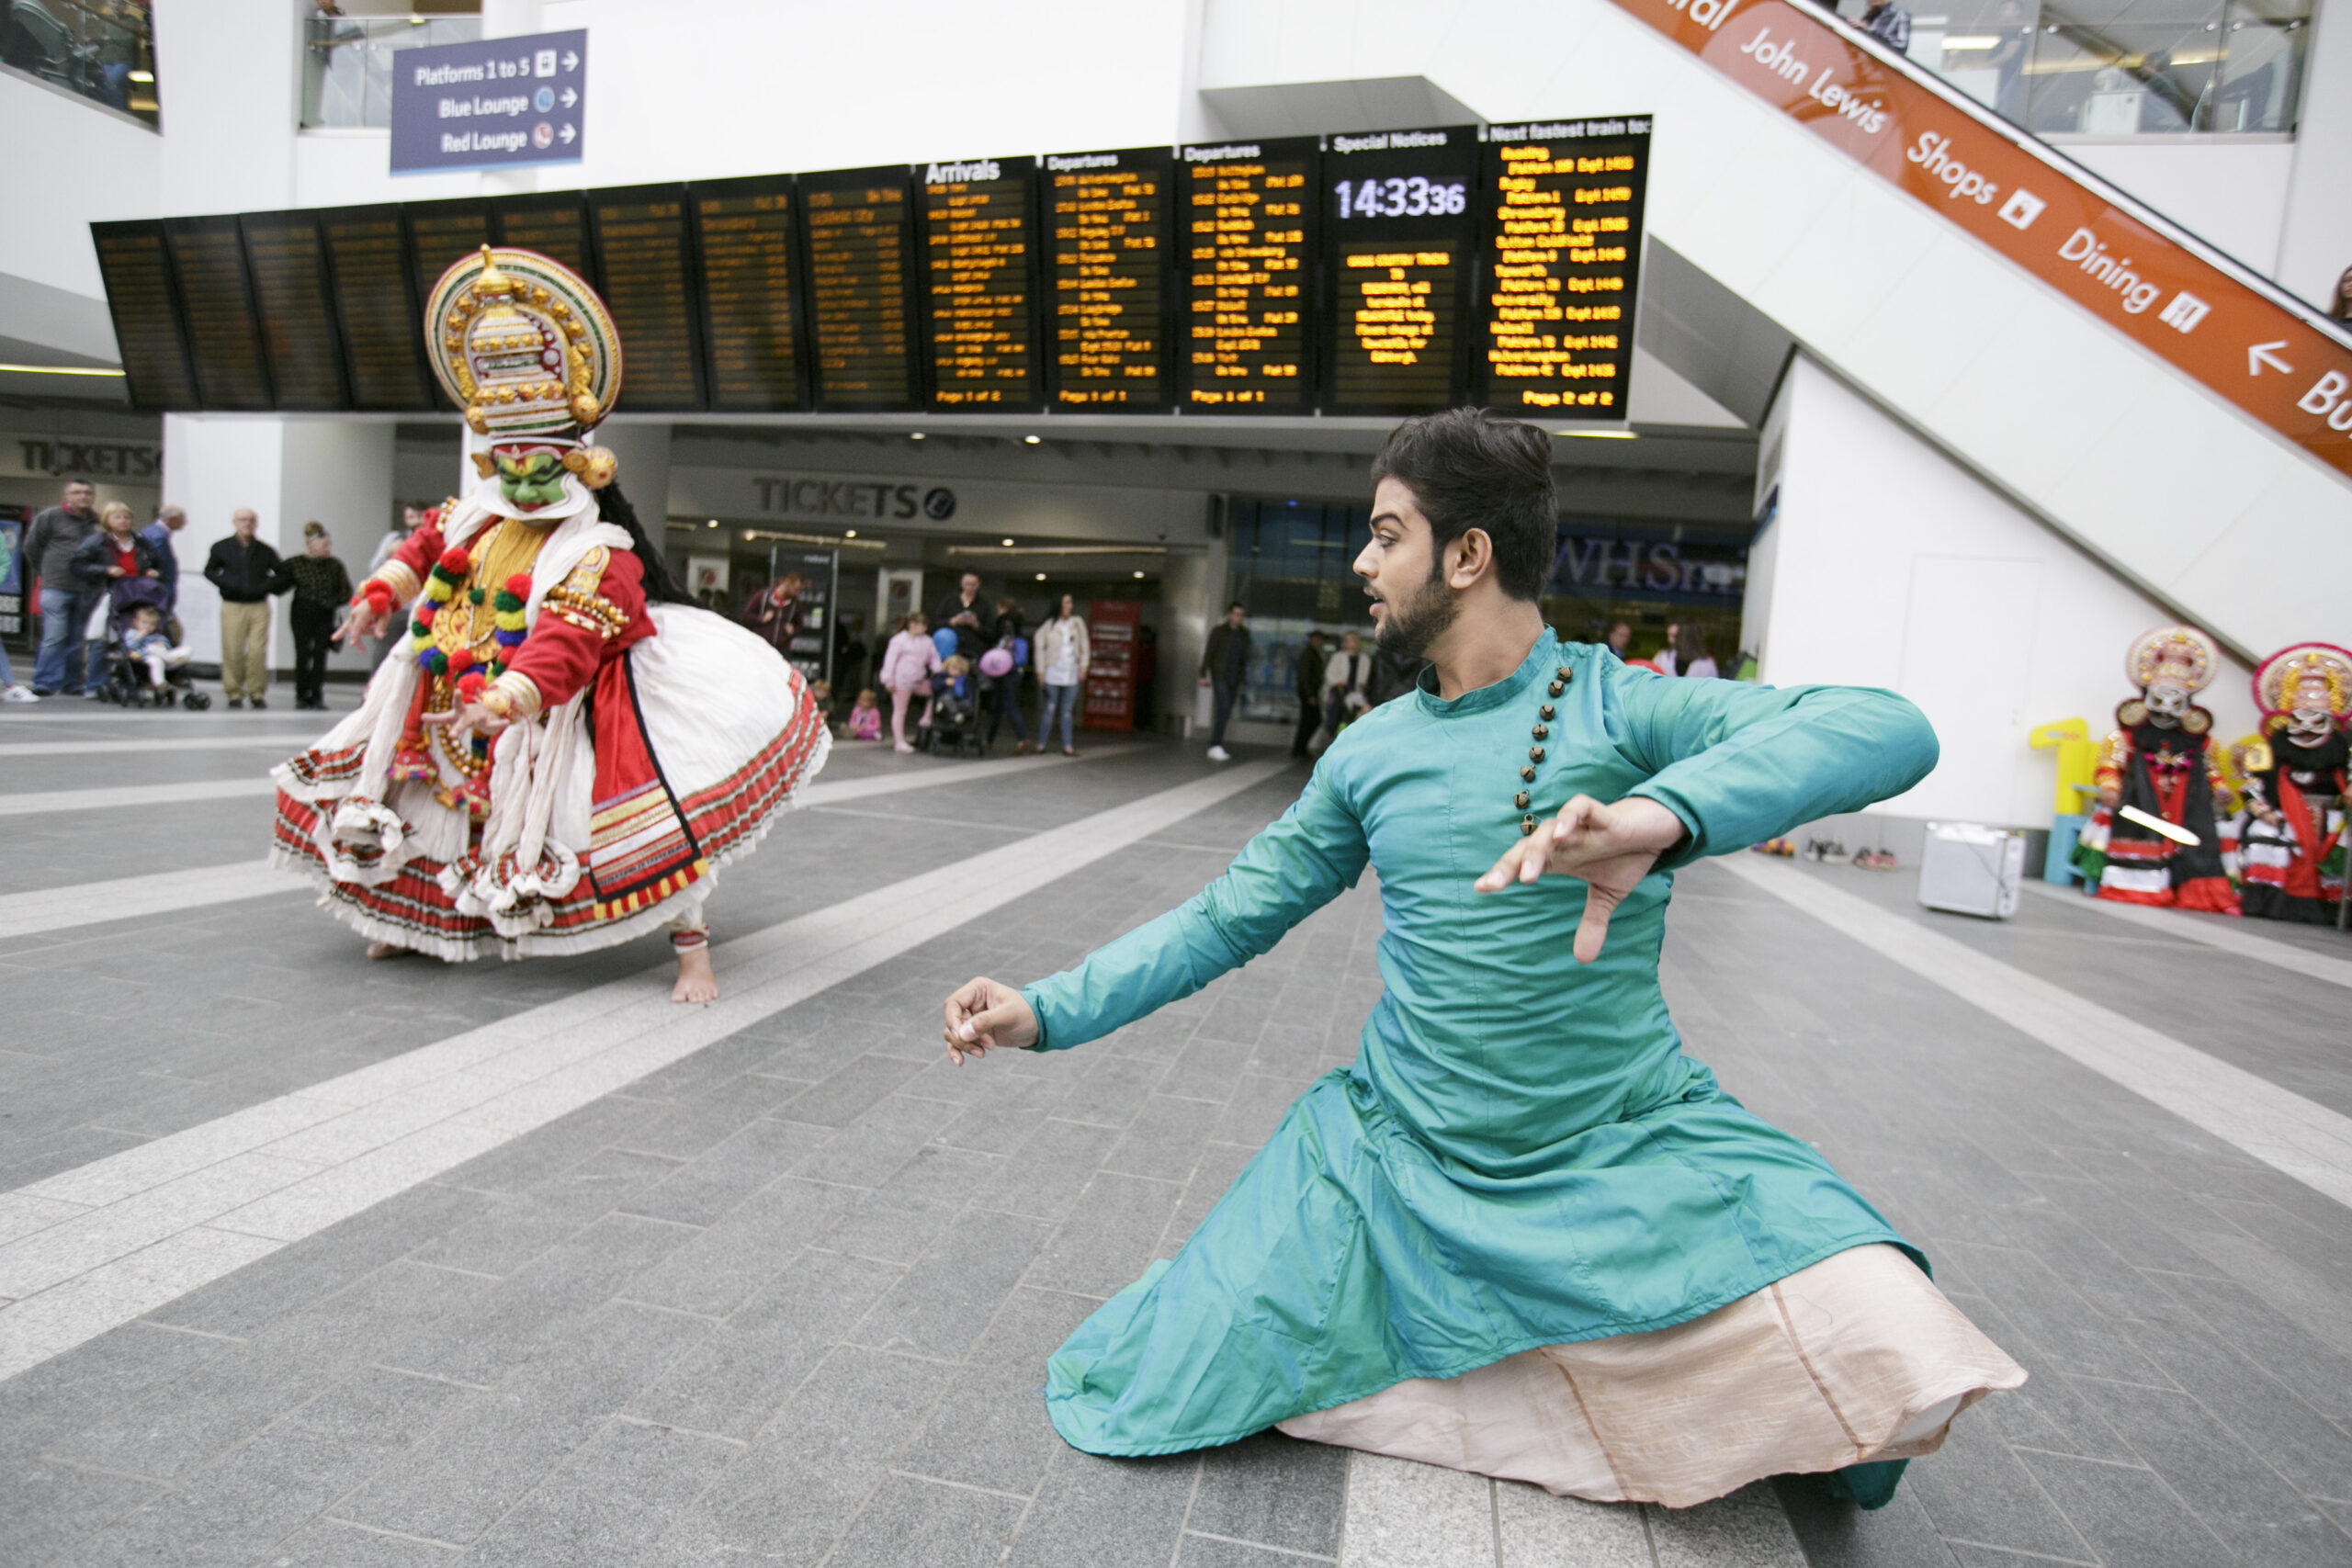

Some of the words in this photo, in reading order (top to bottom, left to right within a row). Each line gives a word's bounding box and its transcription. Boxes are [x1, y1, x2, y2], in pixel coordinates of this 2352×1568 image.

[415, 63, 484, 86] Platforms
[486, 59, 496, 79] 1
[498, 61, 517, 79] to
[518, 56, 530, 76] 5
[1740, 27, 1809, 85] John
[1808, 67, 1885, 133] Lewis
[438, 97, 471, 118] Blue
[472, 95, 529, 117] Lounge
[441, 131, 470, 152] Red
[471, 130, 527, 152] Lounge
[1333, 133, 1388, 154] Special
[1390, 130, 1448, 149] Notices
[1490, 126, 1528, 142] Next
[1529, 120, 1585, 140] fastest
[1587, 118, 1625, 137] train
[1047, 154, 1118, 172] Departures
[1184, 144, 1261, 164] Departures
[925, 159, 1001, 184] Arrivals
[1906, 130, 1998, 205] Shops
[2057, 227, 2161, 314] Dining
[1191, 389, 1223, 404] Page
[1226, 390, 1235, 402] 1
[1236, 390, 1253, 402] of
[1522, 390, 1560, 407] Page
[1562, 391, 1576, 405] 2
[1577, 391, 1598, 405] of
[1600, 391, 1614, 406] 2
[2296, 369, 2352, 439] Bu
[18, 441, 154, 476] TICKETS
[752, 478, 918, 519] TICKETS
